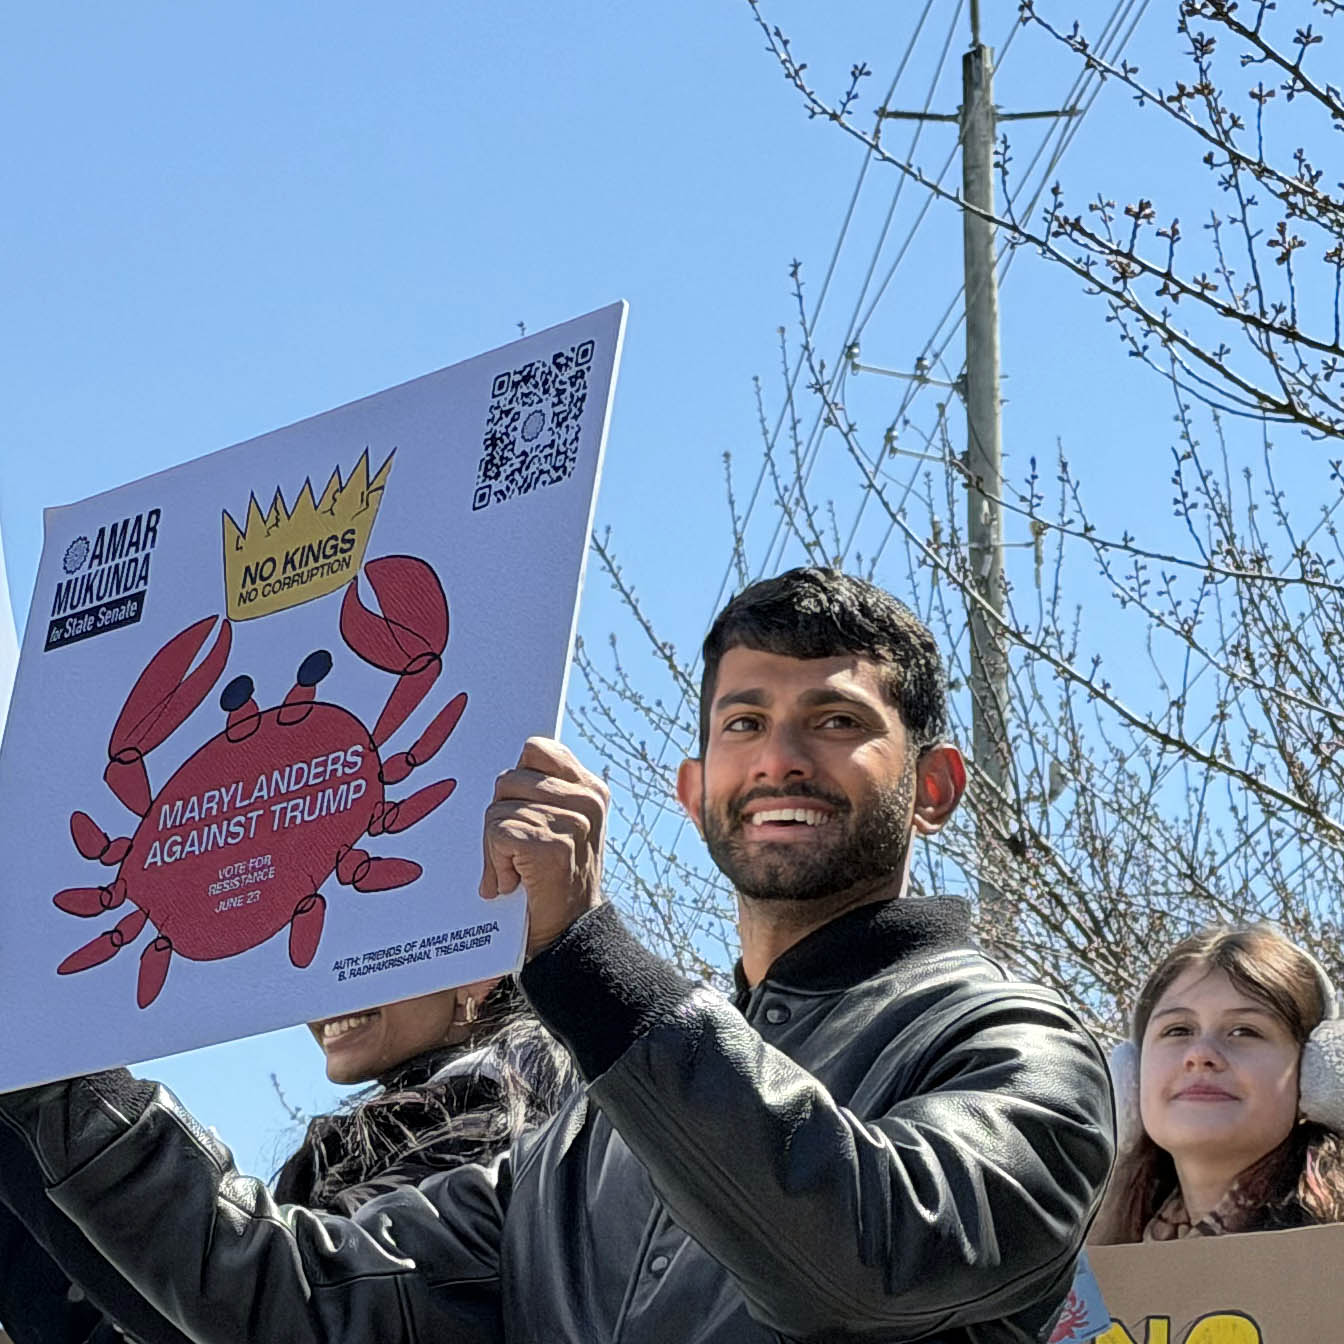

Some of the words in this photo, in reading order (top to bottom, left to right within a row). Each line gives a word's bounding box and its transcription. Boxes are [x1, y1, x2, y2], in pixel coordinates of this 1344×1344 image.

[88, 508, 161, 569] AMAR
[242, 556, 276, 589] NO
[282, 528, 356, 575] KINGS
[51, 552, 151, 617] MUKUNDA
[238, 588, 258, 607] NO
[261, 555, 352, 598] CORRUPTION
[49, 627, 63, 643] for
[64, 614, 95, 638] State
[96, 600, 138, 627] Senate
[158, 744, 364, 831] MARYLANDERS
[143, 810, 264, 870] AGAINST
[270, 778, 367, 832] TRUMP
[208, 866, 276, 896] RESISTANCE
[218, 861, 246, 880] VOTE
[248, 855, 272, 871] FOR
[214, 895, 244, 913] JUNE
[246, 891, 261, 905] 23
[362, 944, 402, 964] FRIENDS
[403, 941, 417, 953] OF
[419, 933, 448, 949] AMAR
[435, 934, 492, 957] TREASURER
